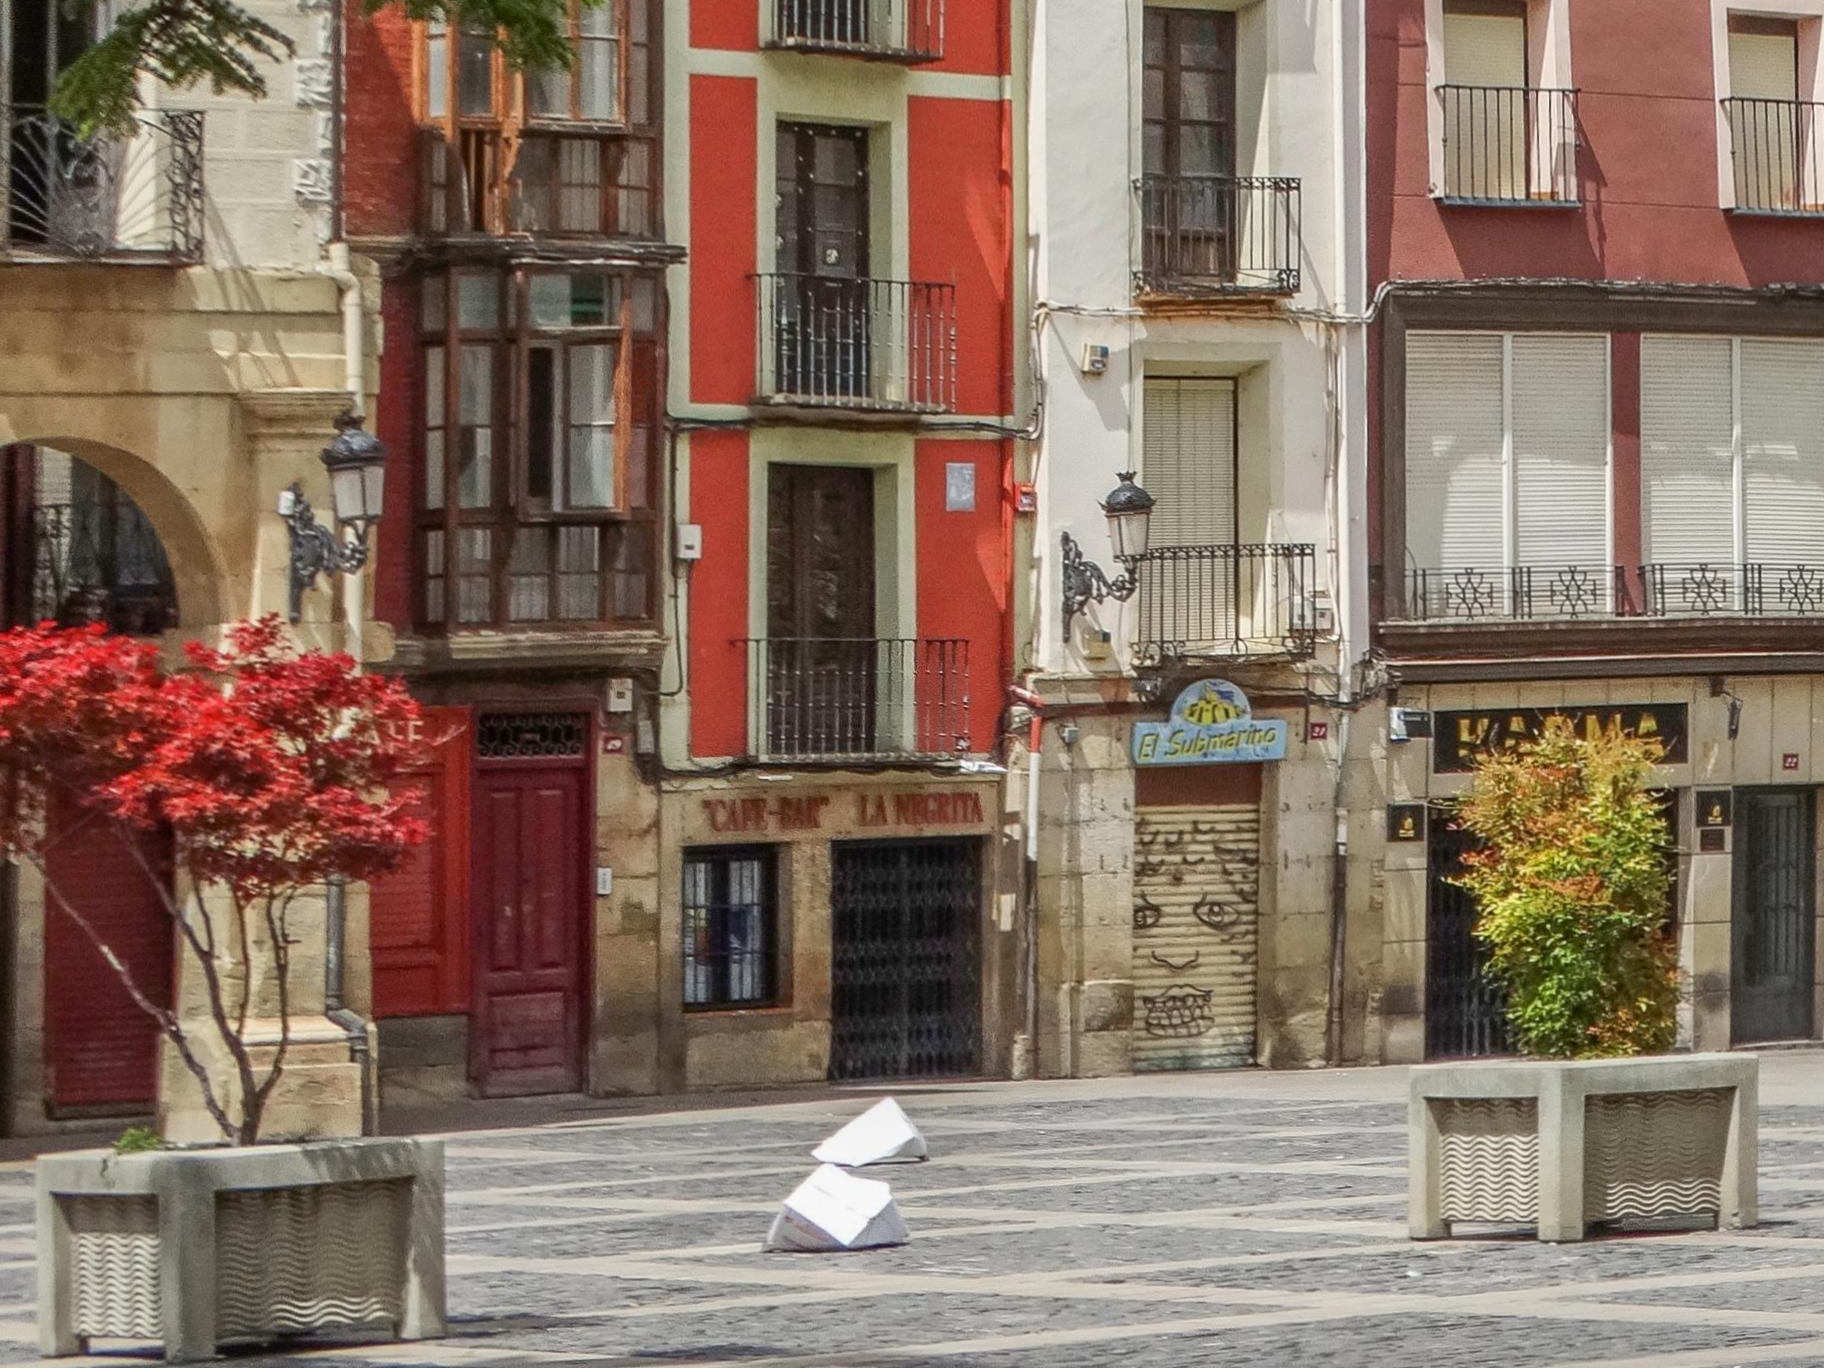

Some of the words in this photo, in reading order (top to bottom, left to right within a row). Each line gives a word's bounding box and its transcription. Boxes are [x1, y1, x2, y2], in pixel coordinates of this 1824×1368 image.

[1138, 731, 1159, 762] El
[1164, 726, 1277, 757] Submarino
[858, 794, 889, 828] LA
[893, 791, 985, 827] NEGRITA
